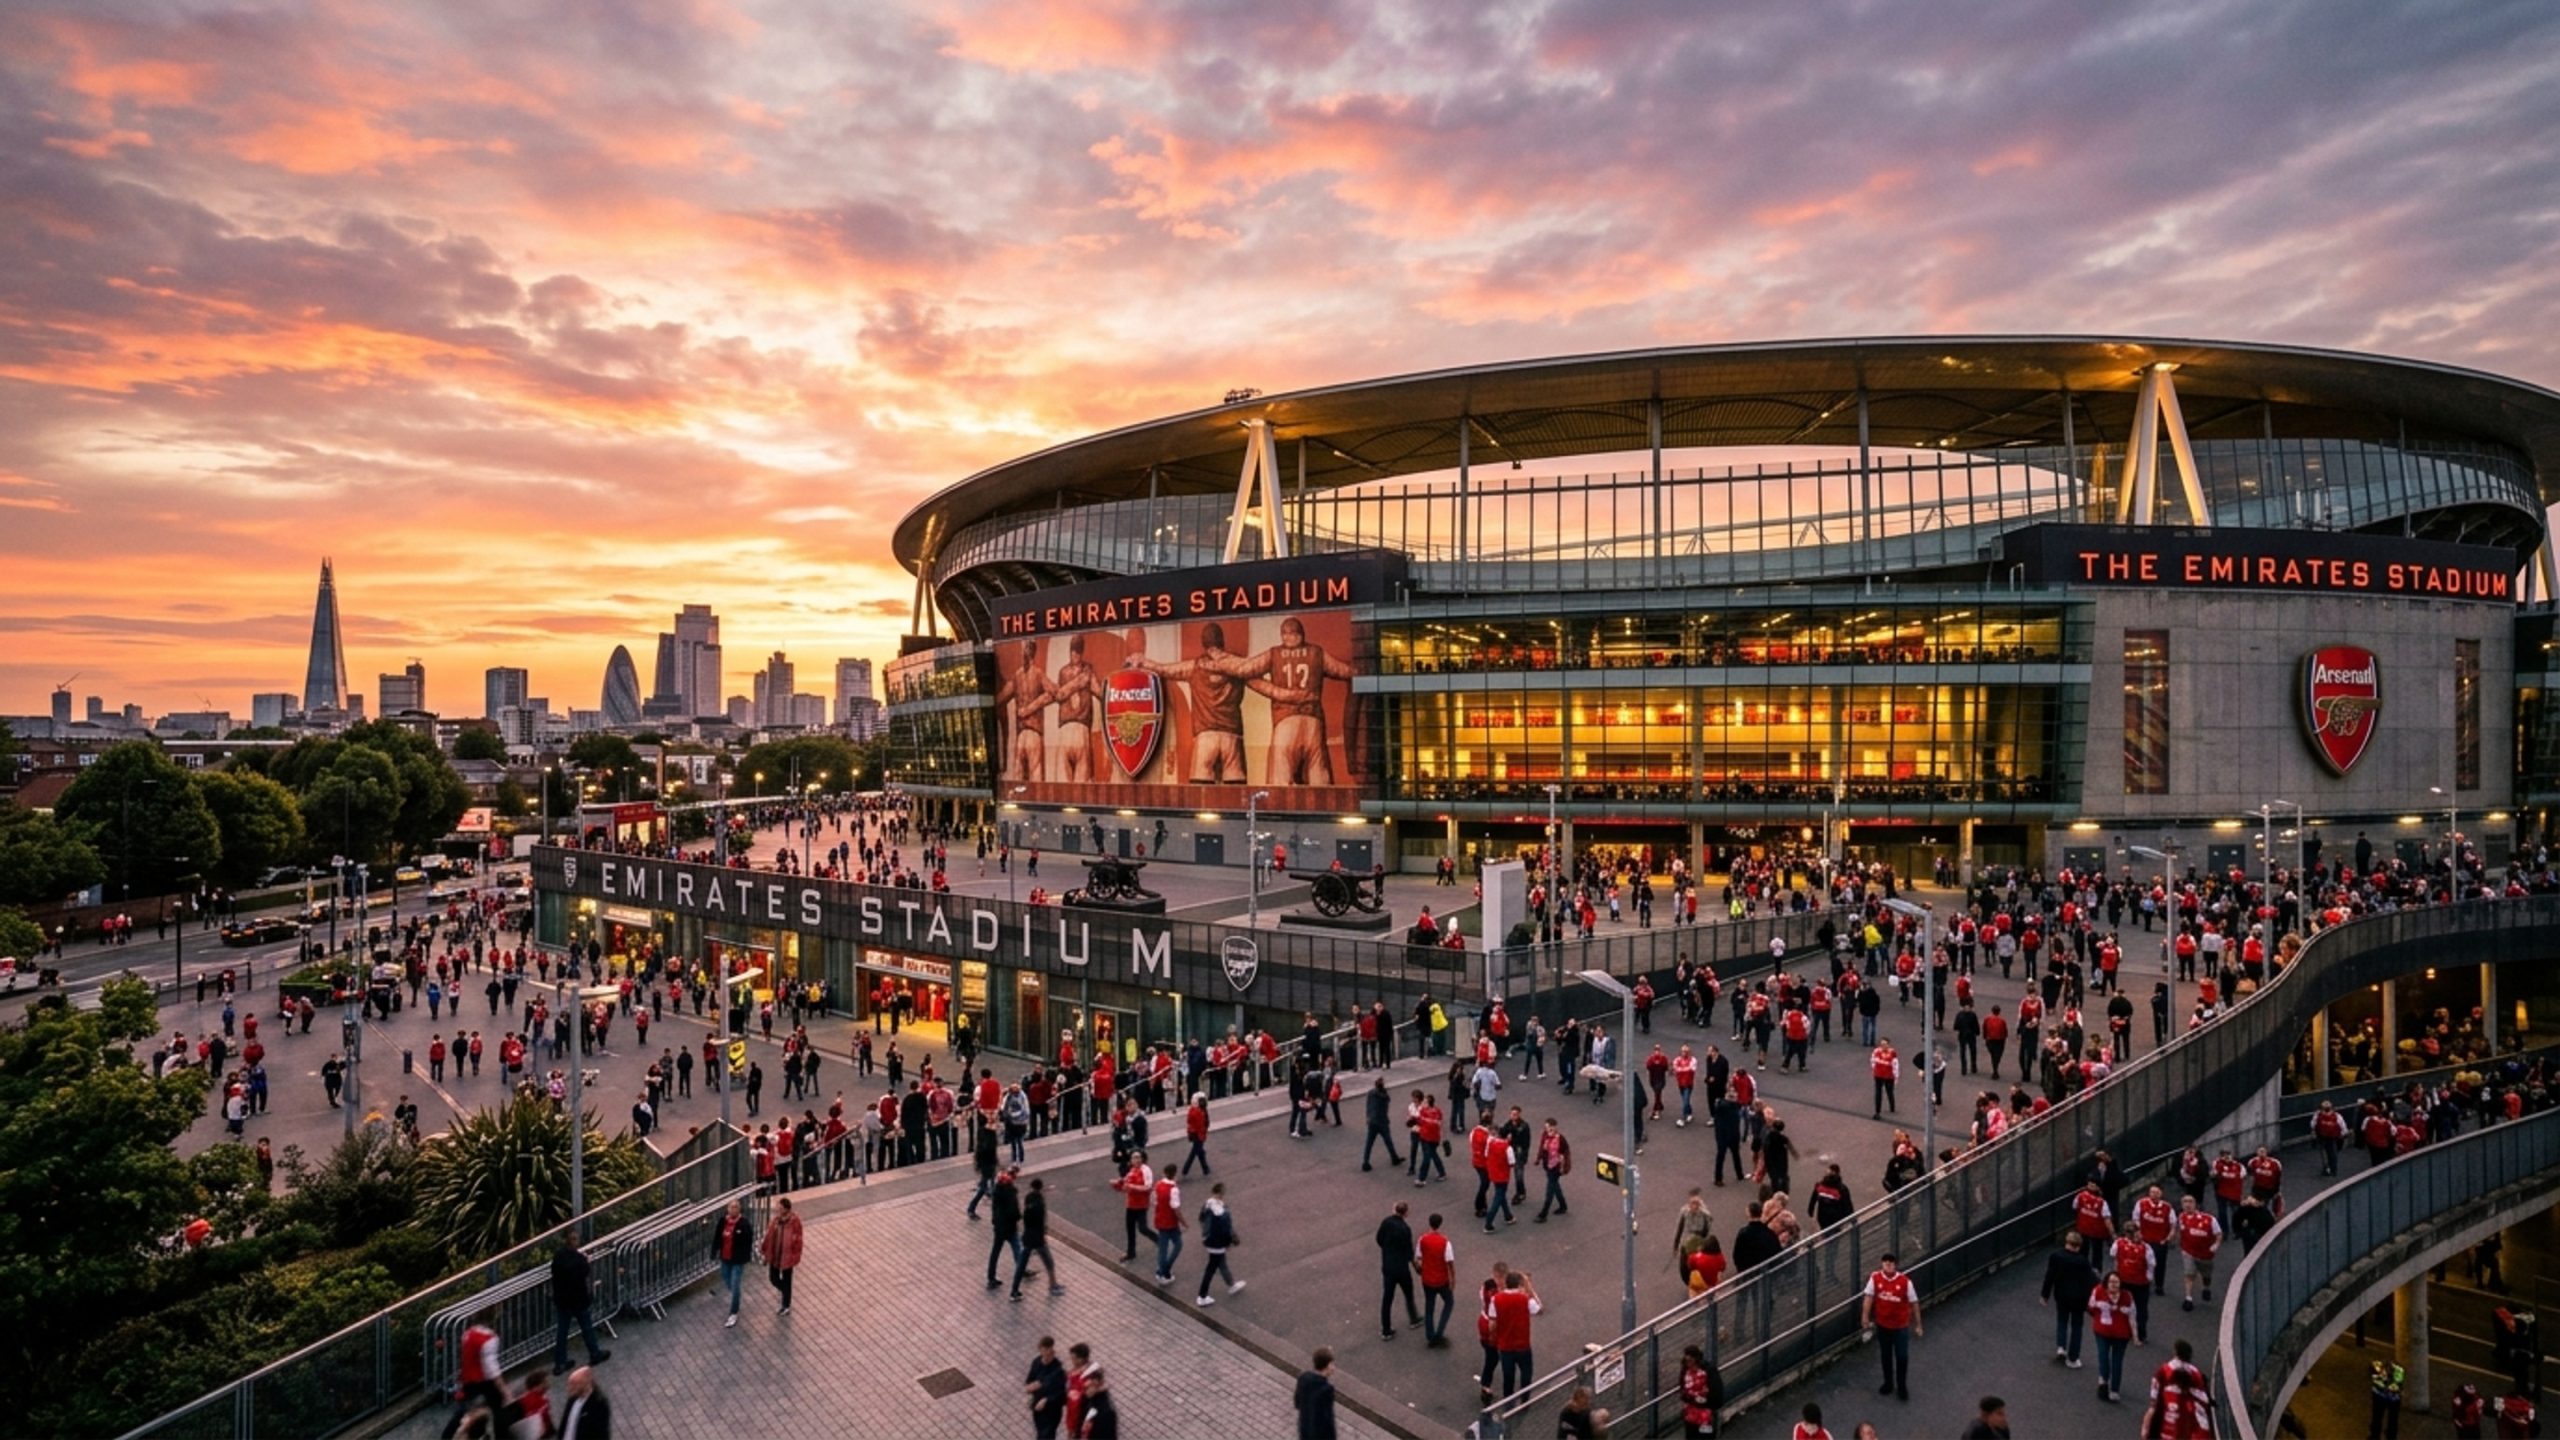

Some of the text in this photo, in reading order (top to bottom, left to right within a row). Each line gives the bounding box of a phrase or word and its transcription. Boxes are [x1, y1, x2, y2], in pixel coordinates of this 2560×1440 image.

[2079, 552, 2507, 597] THE EMIRATES STADIUM
[1001, 576, 1350, 634] THE EMIRATES STADIUM
[601, 862, 1172, 980] EMIRATES STADIUM
